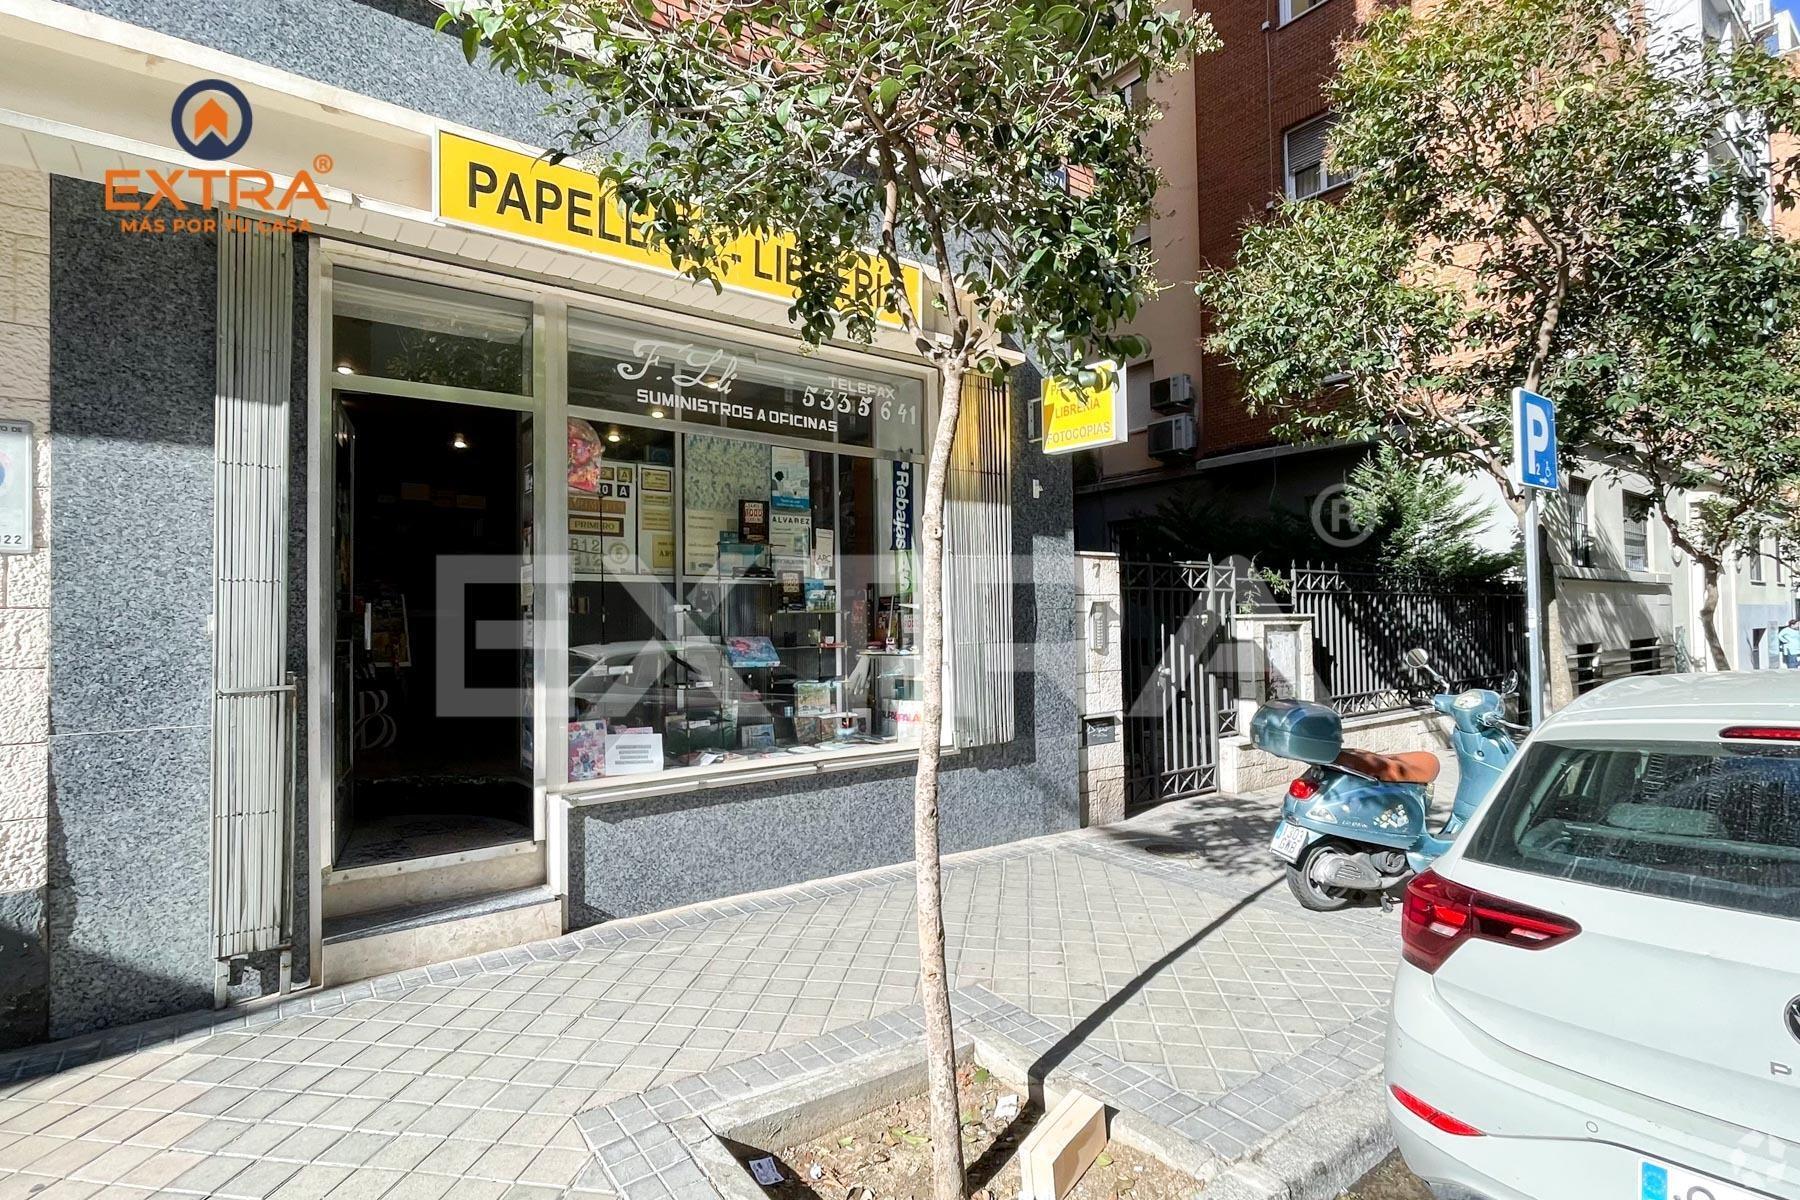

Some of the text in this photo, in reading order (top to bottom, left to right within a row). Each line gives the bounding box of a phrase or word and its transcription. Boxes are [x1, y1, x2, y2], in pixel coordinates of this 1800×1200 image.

[636, 388, 838, 433] SUMINISTROS A OFICINAS
[828, 376, 896, 400] TELEFAX
[1047, 421, 1111, 445] FOTOCOPIAS
[1526, 402, 1549, 475] P
[893, 471, 910, 550] Rebajas
